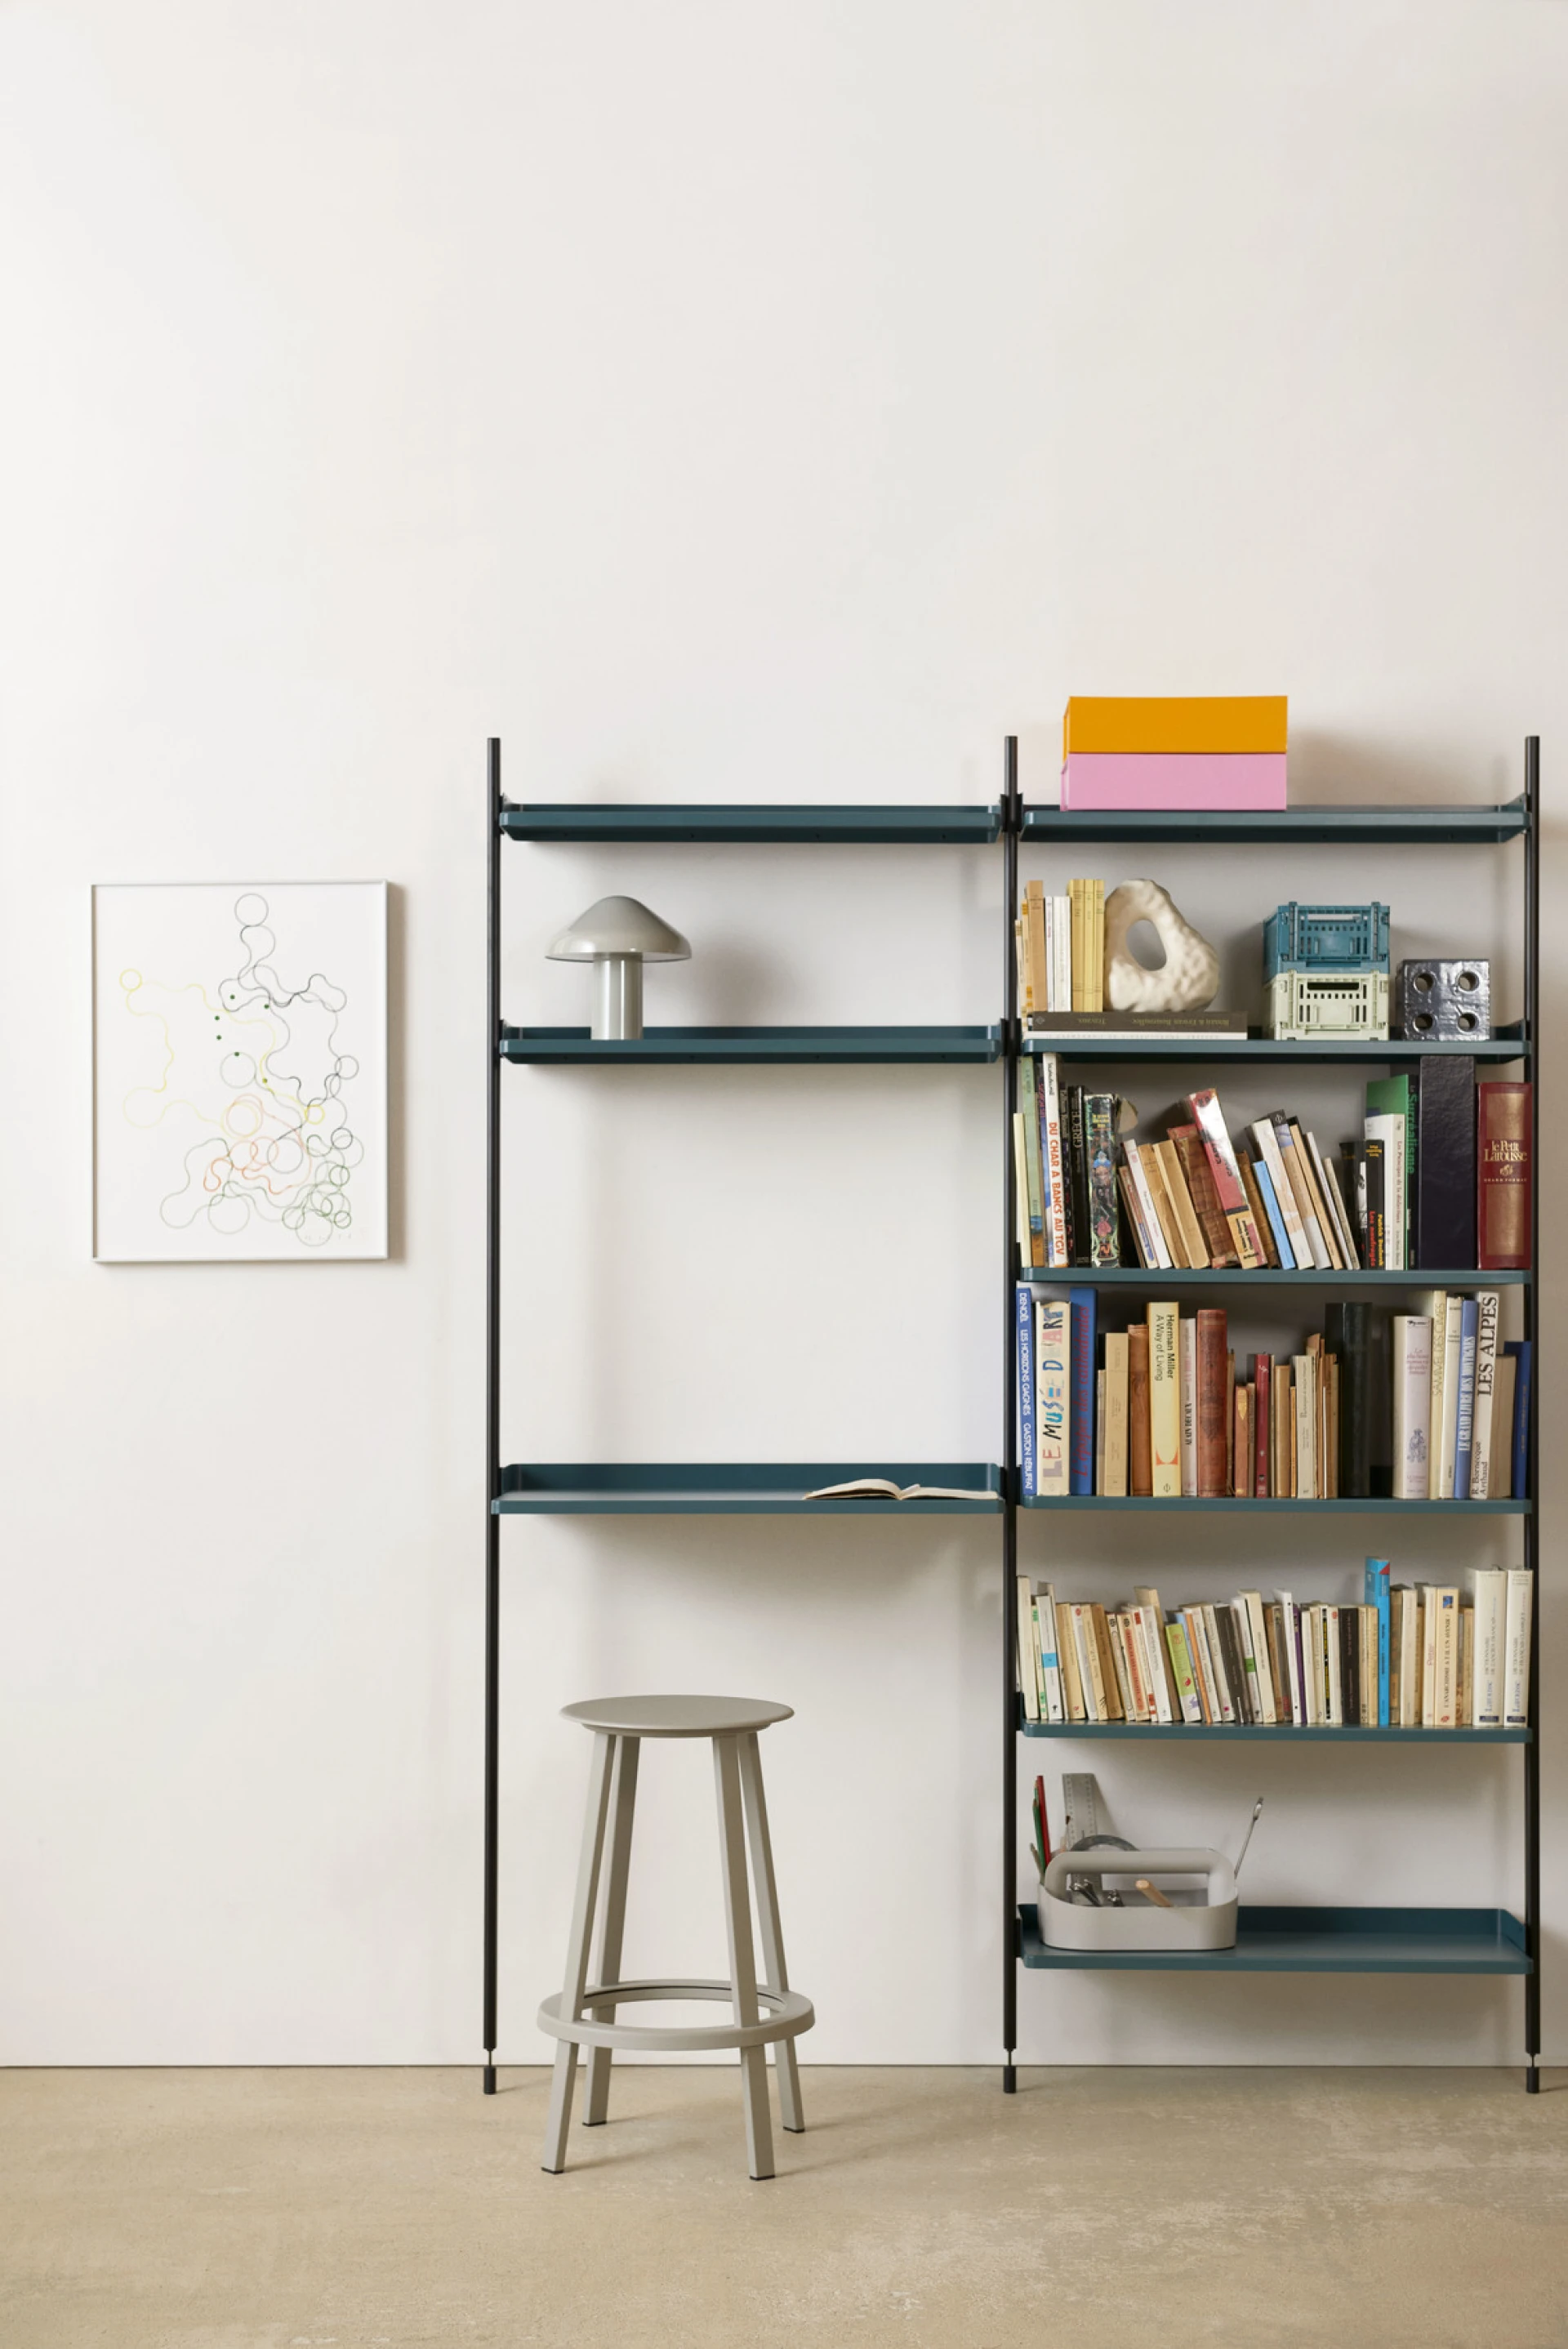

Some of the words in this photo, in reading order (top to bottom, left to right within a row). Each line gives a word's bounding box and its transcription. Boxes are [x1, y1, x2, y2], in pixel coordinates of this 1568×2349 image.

[1049, 1121, 1058, 1135] DU
[1407, 1094, 1417, 1174] Surréalisme
[1049, 1139, 1060, 1166] CHAR
[1483, 1148, 1527, 1161] Larousse
[1491, 1140, 1499, 1152] le
[1500, 1140, 1520, 1152] Petit
[1052, 1170, 1061, 1179] A
[1052, 1183, 1062, 1214] BANCS
[1054, 1218, 1064, 1231] AU
[1055, 1235, 1065, 1255] TGV
[1020, 1330, 1029, 1342] LES
[1154, 1323, 1164, 1342] Way
[1166, 1314, 1174, 1351] Herman
[1479, 1297, 1497, 1357] ALPES
[1070, 1306, 1090, 1384] cathédrales
[1156, 1344, 1165, 1352] of
[1021, 1343, 1031, 1382] HORIZONS
[1154, 1355, 1165, 1381] Living
[1166, 1353, 1174, 1379] Miller
[1477, 1363, 1493, 1397] LES
[1039, 1379, 1064, 1439] MUSÉE
[1073, 1390, 1089, 1412] des
[1023, 1423, 1032, 1455] GASTON
[1071, 1416, 1091, 1477] L'épopée
[1042, 1446, 1062, 1477] LE
[1479, 1461, 1489, 1495] Arthaud
